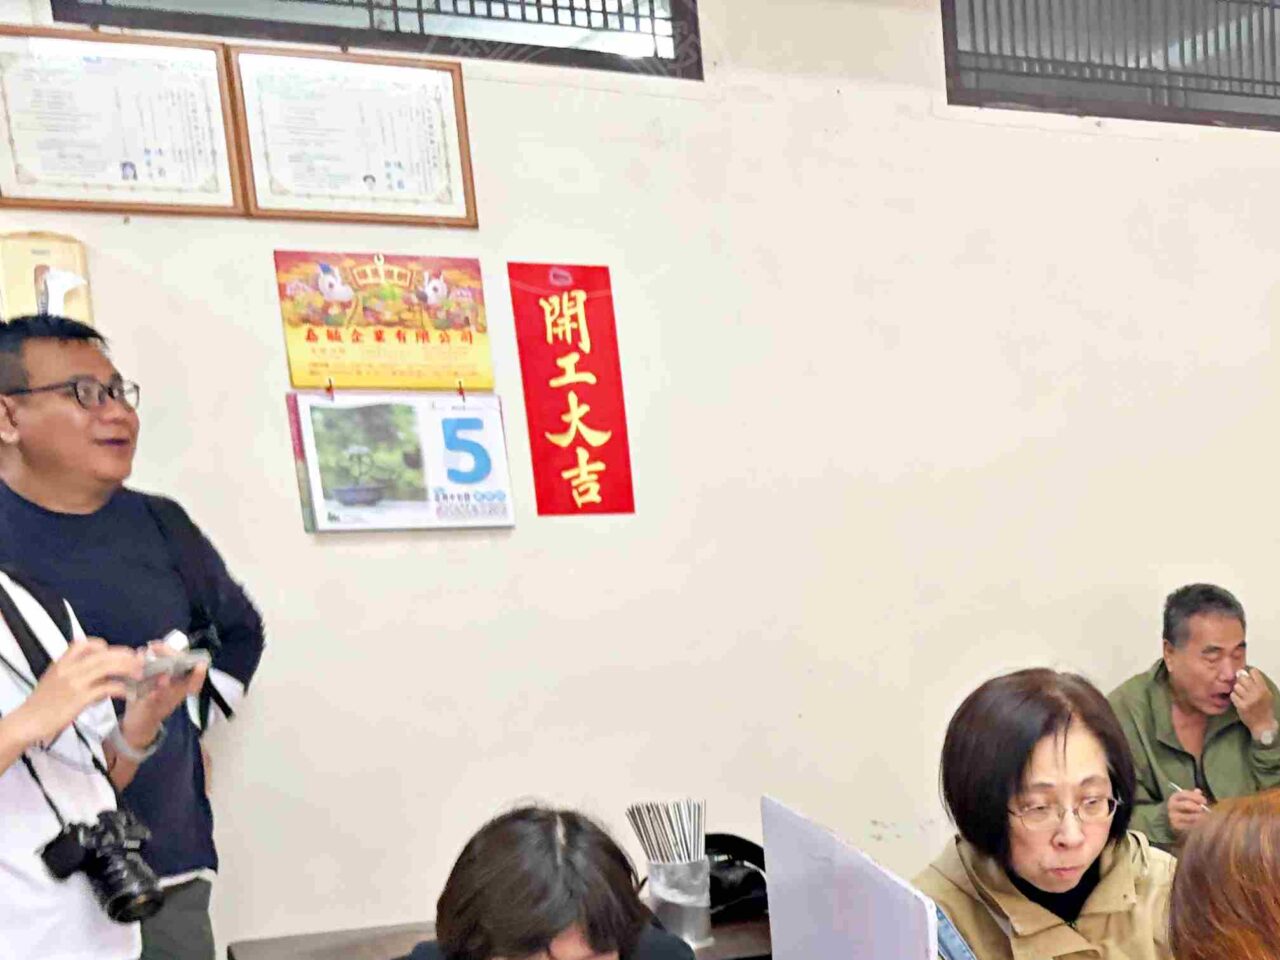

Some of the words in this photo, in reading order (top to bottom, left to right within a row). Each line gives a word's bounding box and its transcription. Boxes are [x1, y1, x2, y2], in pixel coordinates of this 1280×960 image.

[441, 418, 492, 484] 5
[539, 290, 612, 508] 開工大吉
